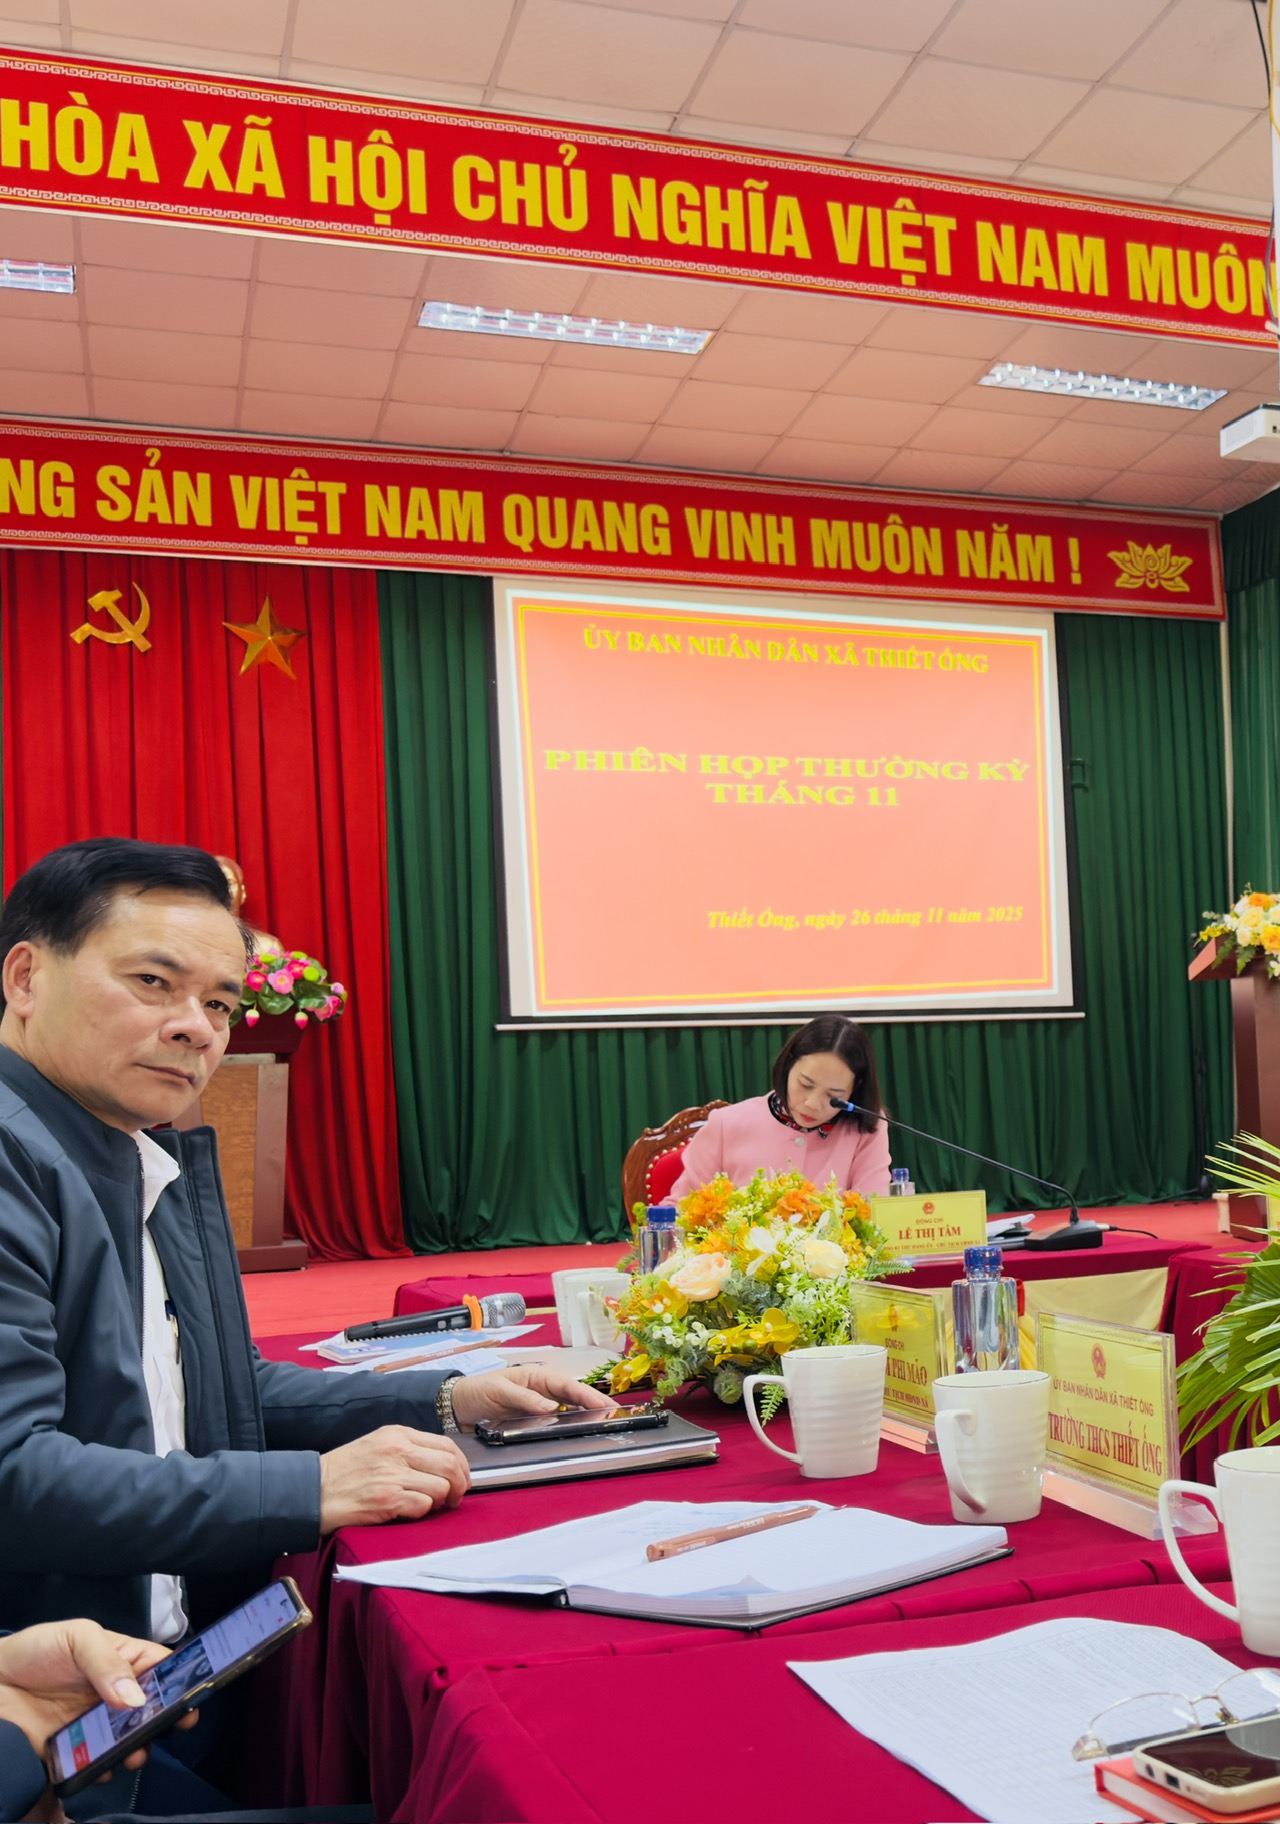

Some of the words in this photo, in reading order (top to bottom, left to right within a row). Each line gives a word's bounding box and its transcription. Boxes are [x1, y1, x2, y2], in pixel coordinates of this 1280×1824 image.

[0, 91, 160, 183] HÒA
[183, 115, 285, 198] XÃ
[308, 130, 427, 226] HỘI
[453, 143, 588, 232] CHỦ
[612, 174, 811, 259] NGHĨA
[827, 198, 957, 286] VIỆT
[976, 221, 1108, 296] NAM
[1126, 243, 1280, 318] MUÔN
[0, 457, 75, 518] NG
[96, 448, 212, 527] SẢN
[229, 468, 347, 545] VIỆT
[364, 485, 486, 542] NAM
[503, 494, 672, 555] QUANG
[684, 508, 796, 566] VINH
[810, 514, 944, 576] MUÔN
[957, 524, 1055, 583] NĂM
[1068, 538, 1081, 584] !
[583, 624, 621, 650] ỦY
[627, 631, 682, 654] BAN
[688, 633, 761, 660] NHÂN
[767, 637, 818, 663] DÂN
[824, 642, 860, 666] XÃ
[543, 746, 688, 773] PHIÊN
[698, 754, 789, 780] HỌP
[795, 755, 969, 780] THƯỜNG
[705, 779, 855, 806] THÁNG
[866, 786, 900, 806] 11
[805, 909, 847, 930] ngày
[850, 908, 871, 926] 26
[874, 908, 922, 928] tháng
[927, 907, 944, 923] 11
[947, 908, 982, 923] năm
[987, 906, 1023, 923] 2025
[898, 1227, 912, 1240] LÊ
[915, 1228, 935, 1241] THỊ
[938, 1224, 961, 1237] TÂM
[1063, 1380, 1076, 1394] BAN
[1076, 1383, 1094, 1400] NHÂN
[1094, 1387, 1108, 1404] DÂN
[1048, 1408, 1085, 1449] TRƯỜNG
[1086, 1423, 1110, 1458] THCS
[1111, 1419, 1140, 1469] THIẾT
[1142, 1424, 1162, 1476] ỐNG
